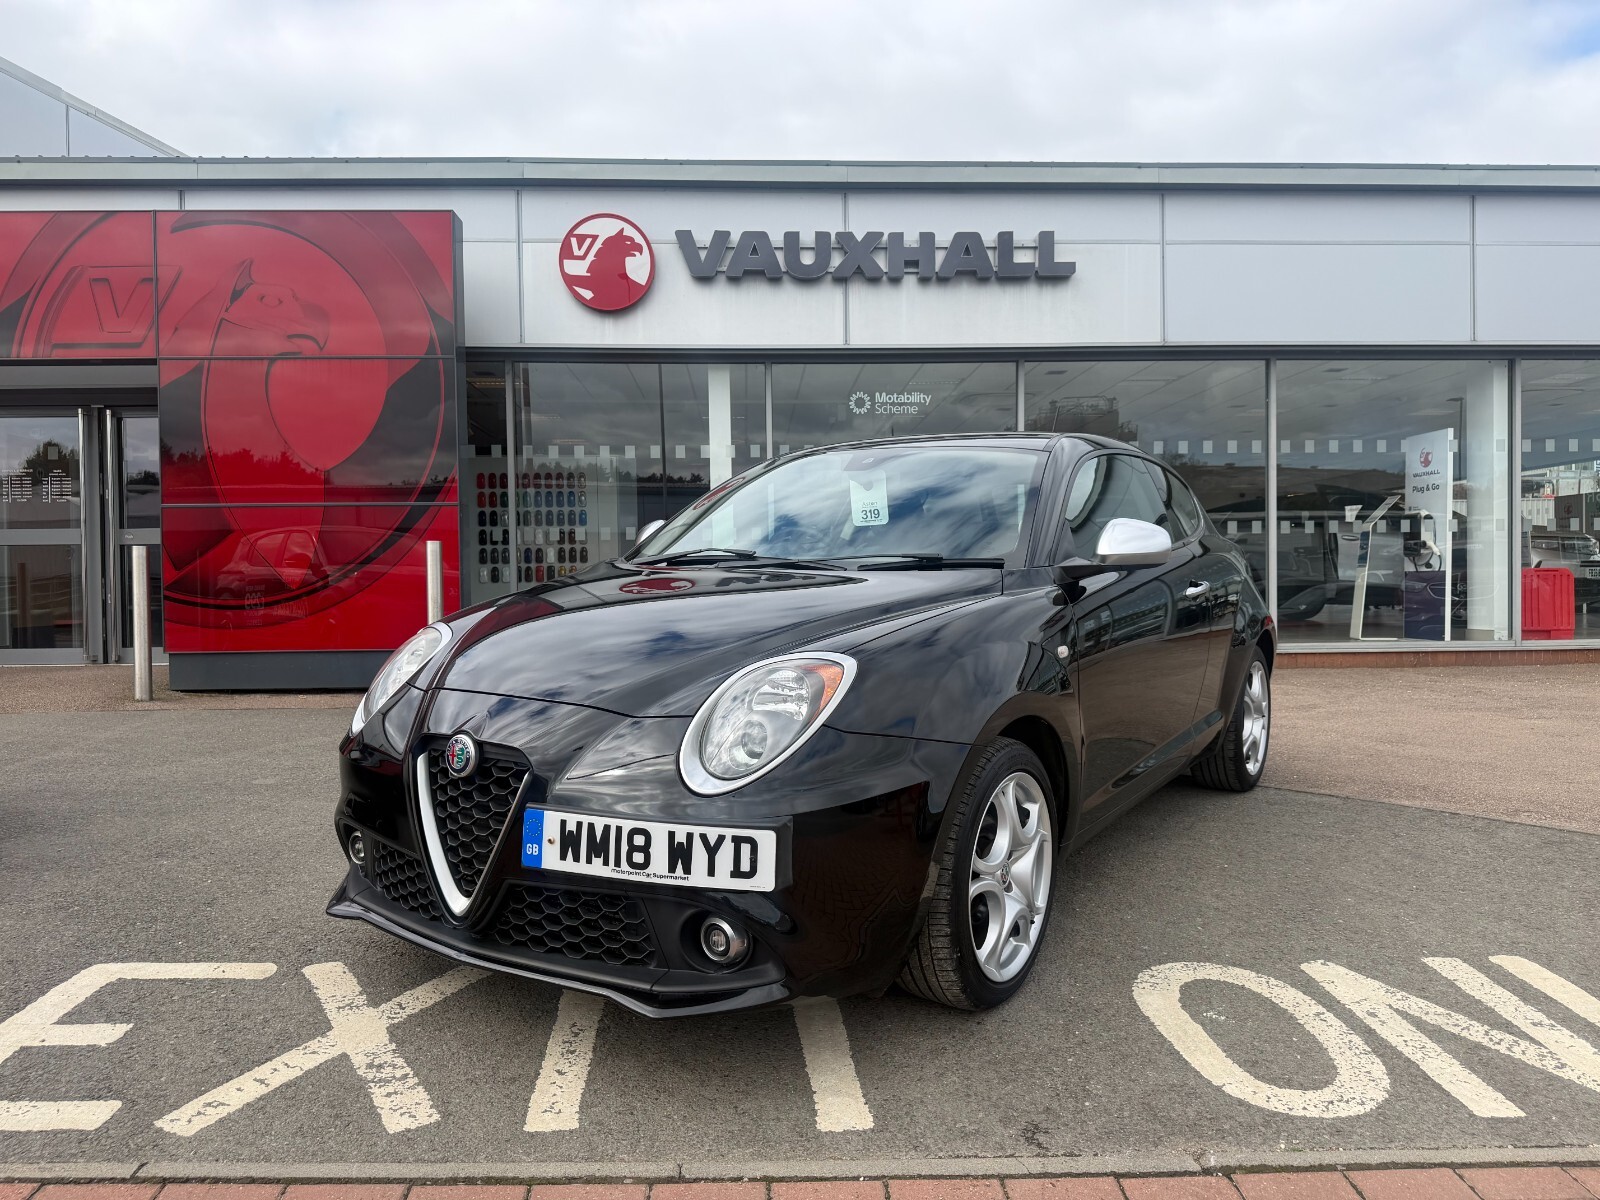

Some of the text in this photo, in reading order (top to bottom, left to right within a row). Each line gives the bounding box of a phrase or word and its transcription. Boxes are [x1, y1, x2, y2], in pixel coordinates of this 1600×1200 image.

[674, 229, 1077, 280] VAUXHALL
[875, 391, 932, 406] Motability
[875, 403, 919, 414] Scheme
[1412, 469, 1441, 478] VAUXHALL
[1412, 483, 1440, 494] Plug & Go
[861, 508, 880, 520] 319
[526, 843, 539, 856] GB
[559, 818, 759, 880] WM18 WYD
[652, 872, 690, 881] Supermarket
